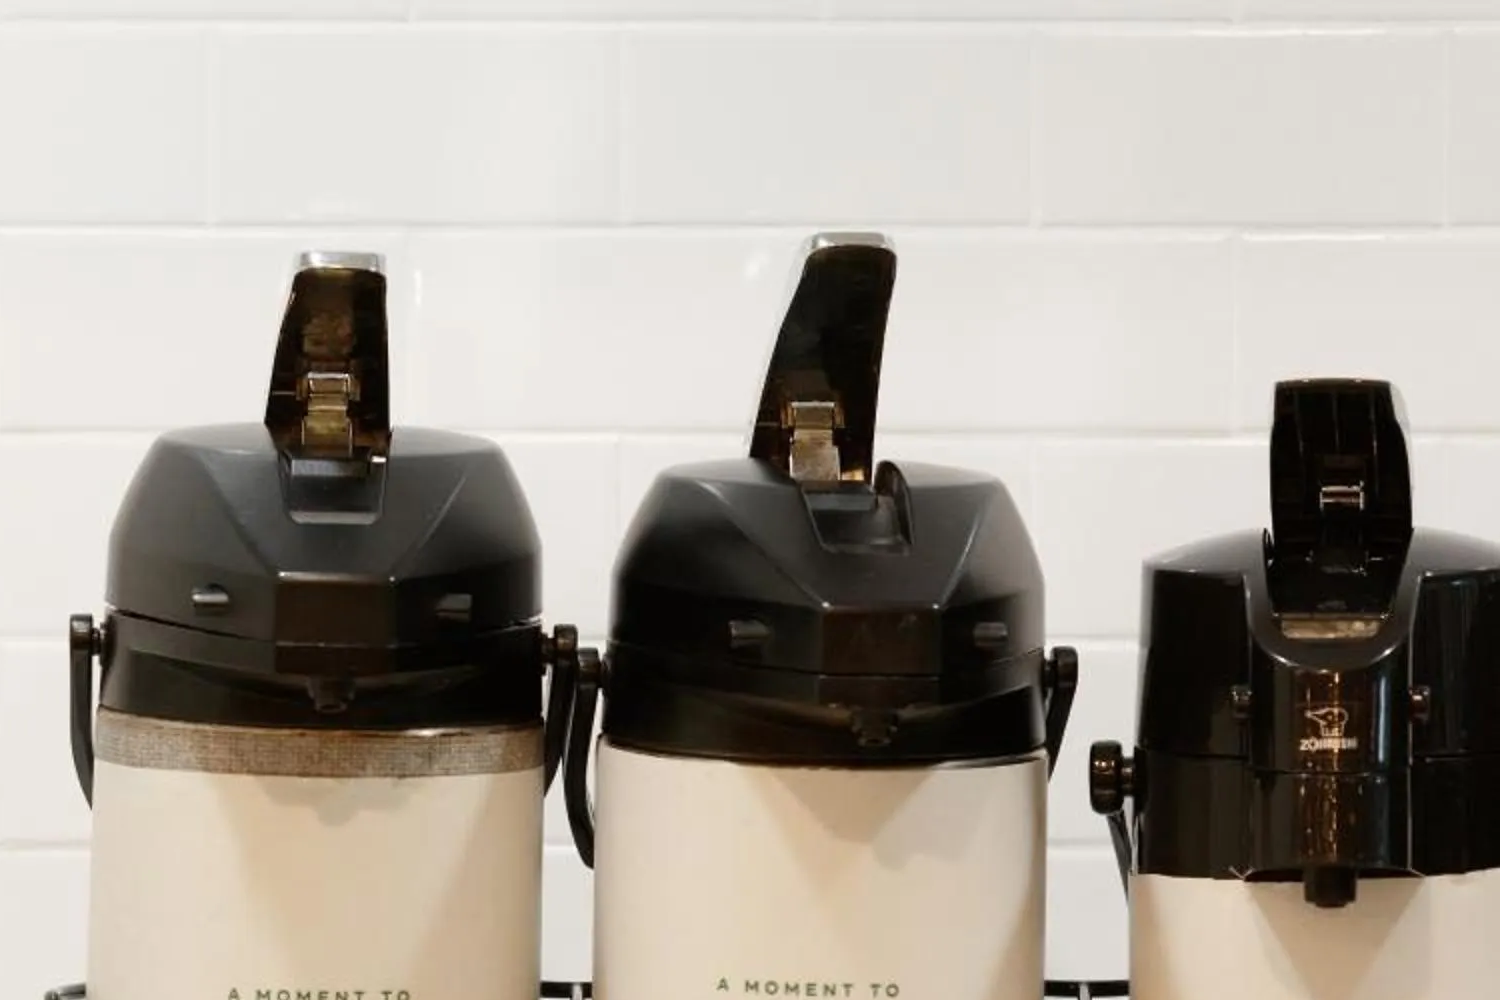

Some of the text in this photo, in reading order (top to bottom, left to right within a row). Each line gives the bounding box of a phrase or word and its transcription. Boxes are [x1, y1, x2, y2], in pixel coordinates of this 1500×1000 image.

[716, 977, 900, 998] A MOMENT TO
